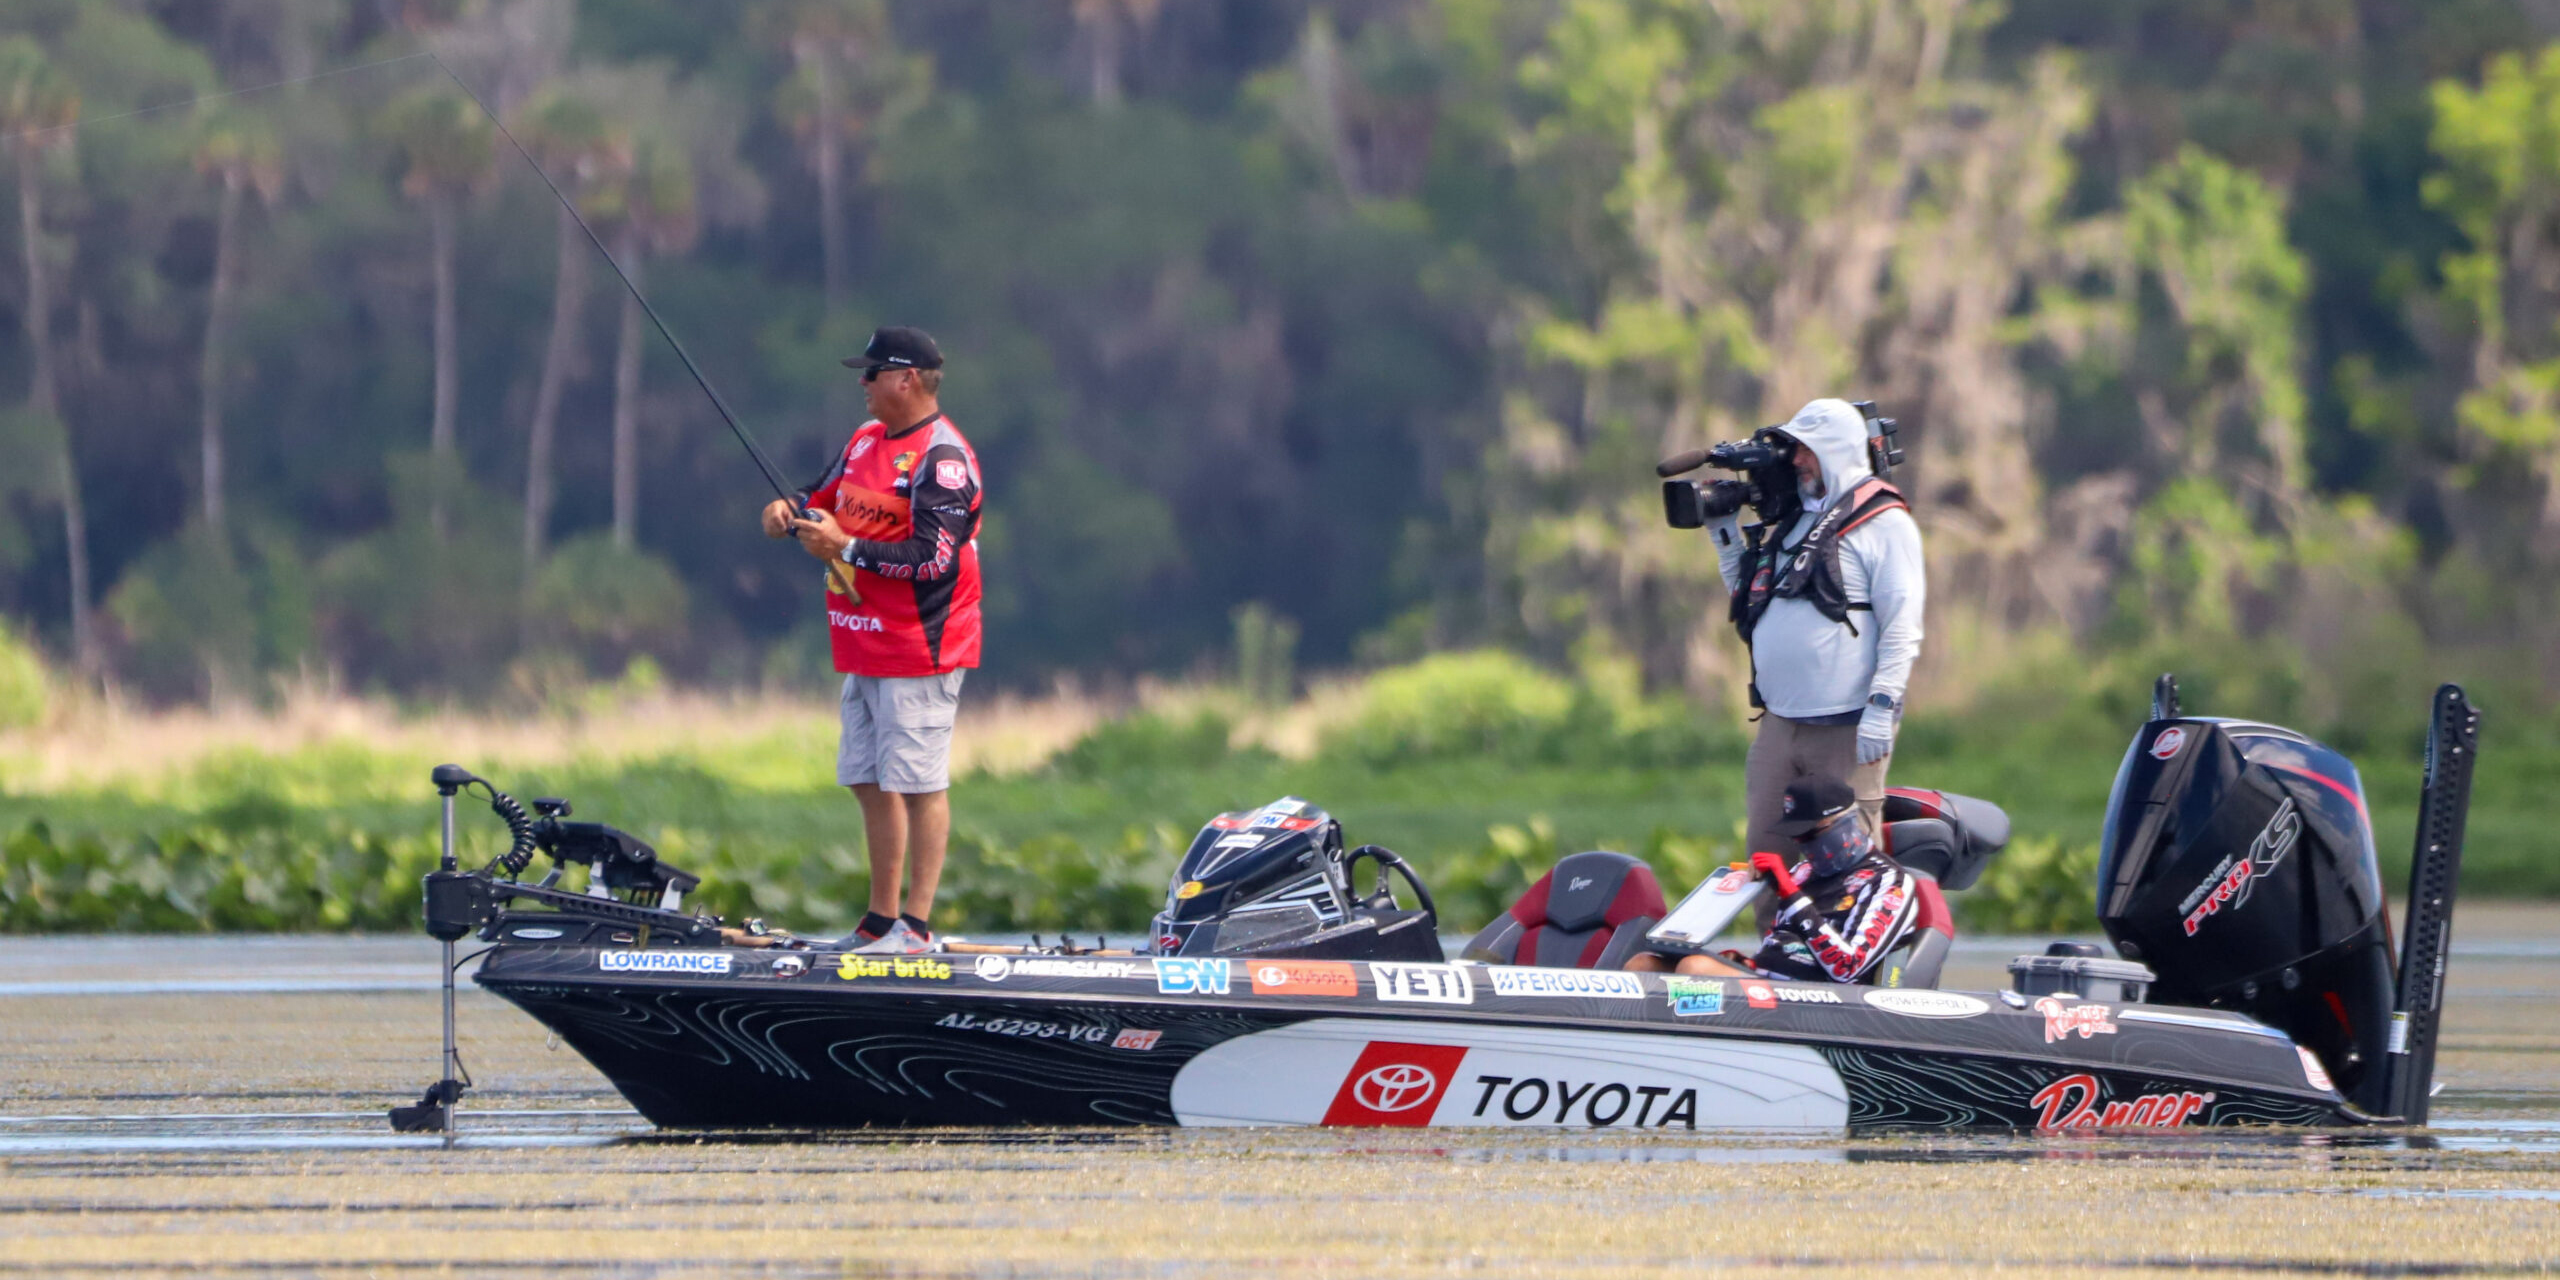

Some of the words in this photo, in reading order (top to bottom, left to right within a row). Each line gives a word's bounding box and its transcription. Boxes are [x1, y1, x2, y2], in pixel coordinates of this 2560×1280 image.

[843, 495, 898, 525] Kubota
[828, 610, 883, 632] TOYOTA
[2182, 857, 2252, 938] PRO
[1864, 910, 1895, 950] OIL
[602, 953, 728, 970] LOWRANCE
[1013, 959, 1136, 978] MERCURY
[1286, 968, 1349, 985] Kubota
[1376, 967, 1466, 999] YETI
[1518, 972, 1640, 994] FERGUSON
[1773, 987, 1843, 1003] TOYOTA
[936, 1012, 1108, 1042] AL-6293-VG
[1116, 1036, 1153, 1049] OCT
[1472, 1075, 1698, 1131] TOYOTA
